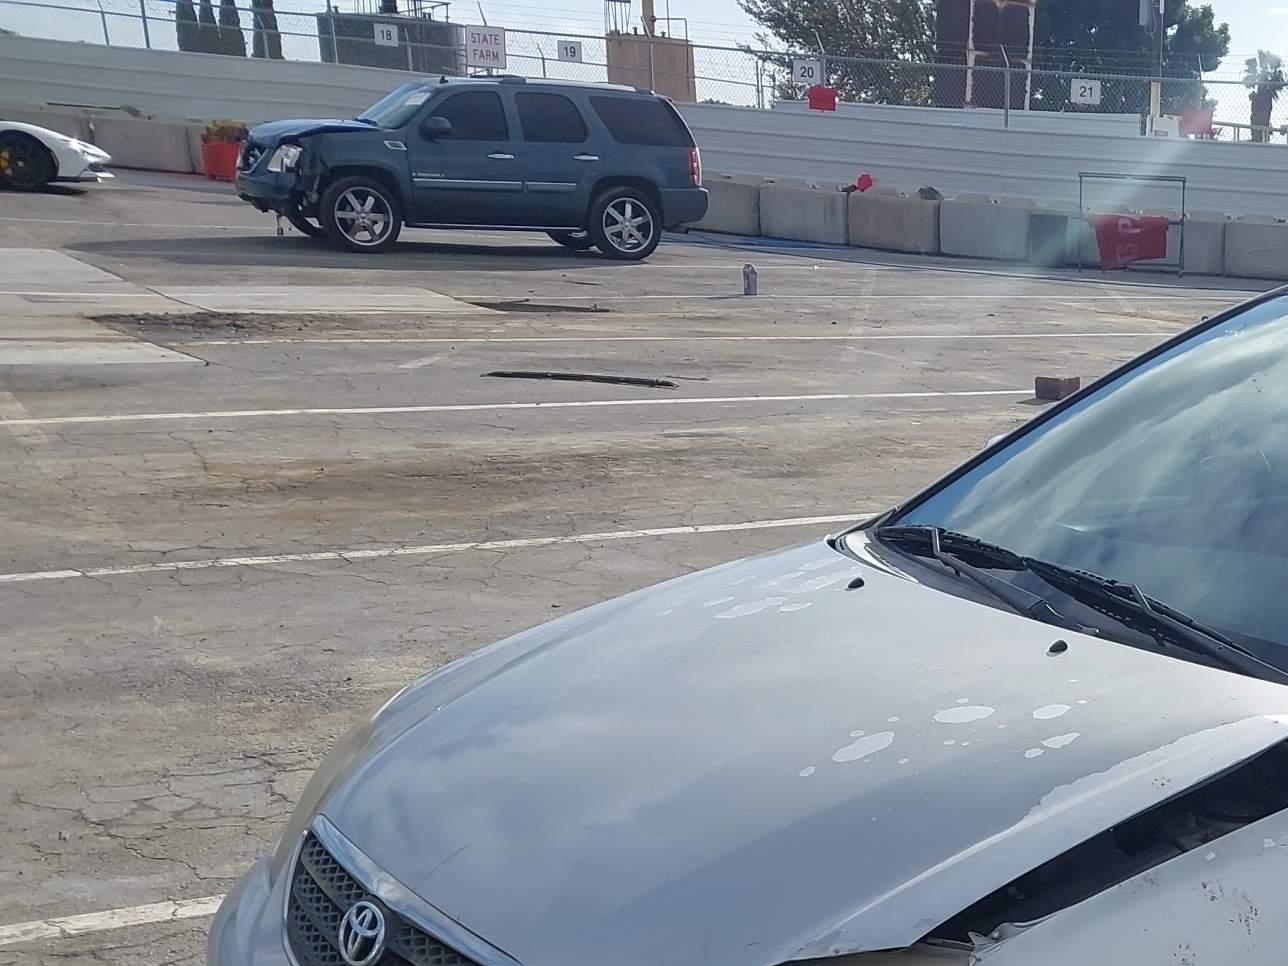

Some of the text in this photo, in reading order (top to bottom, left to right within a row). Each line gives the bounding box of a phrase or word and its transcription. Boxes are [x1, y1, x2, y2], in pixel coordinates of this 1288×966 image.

[380, 29, 392, 41] 18
[470, 32, 500, 46] STATE
[473, 50, 499, 63] FARM
[563, 46, 576, 58] 19
[800, 65, 814, 78] 20
[1079, 85, 1093, 98] 21
